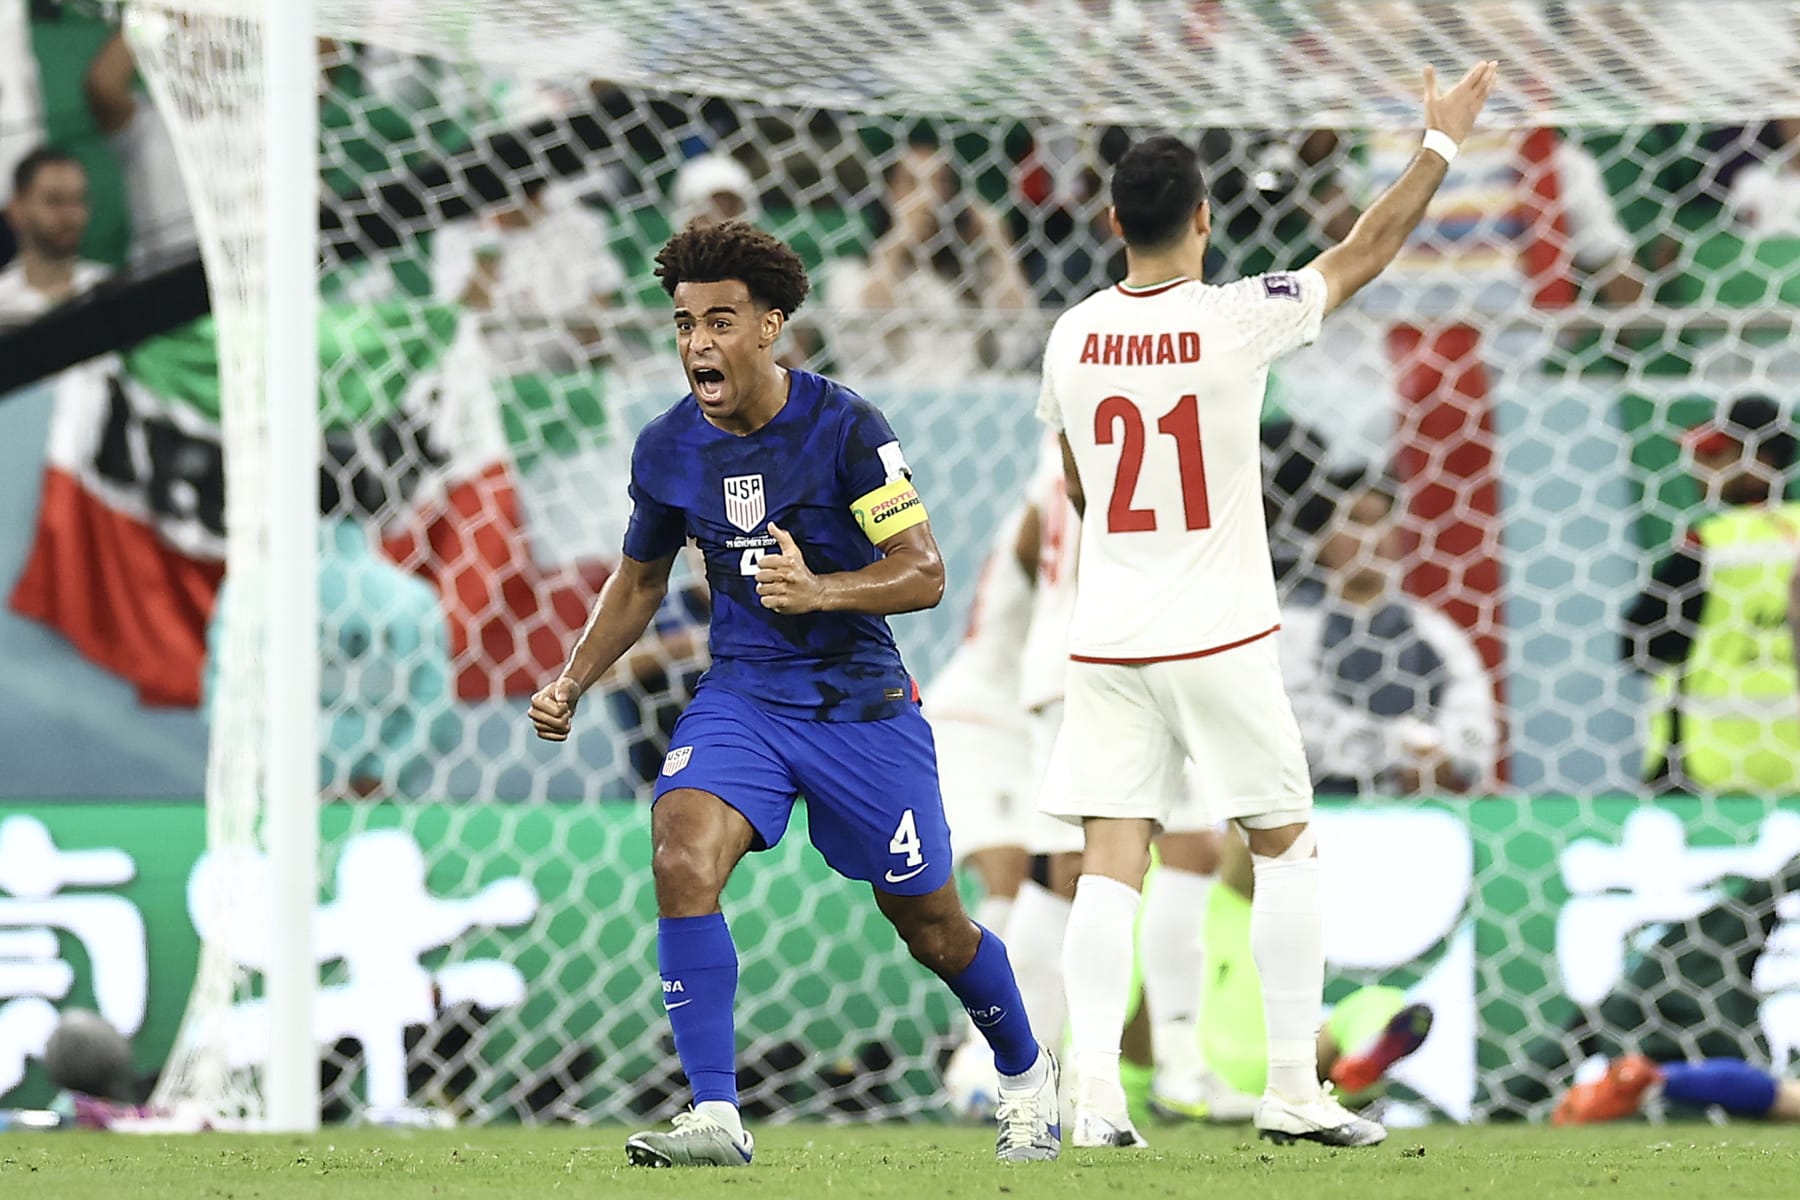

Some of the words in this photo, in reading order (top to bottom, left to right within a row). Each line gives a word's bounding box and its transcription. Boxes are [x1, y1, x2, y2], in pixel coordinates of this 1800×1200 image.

[1080, 332, 1201, 366] AHMAD
[1094, 394, 1211, 533] 21
[727, 478, 760, 500] USA
[667, 748, 690, 761] USA
[889, 809, 922, 867] 4
